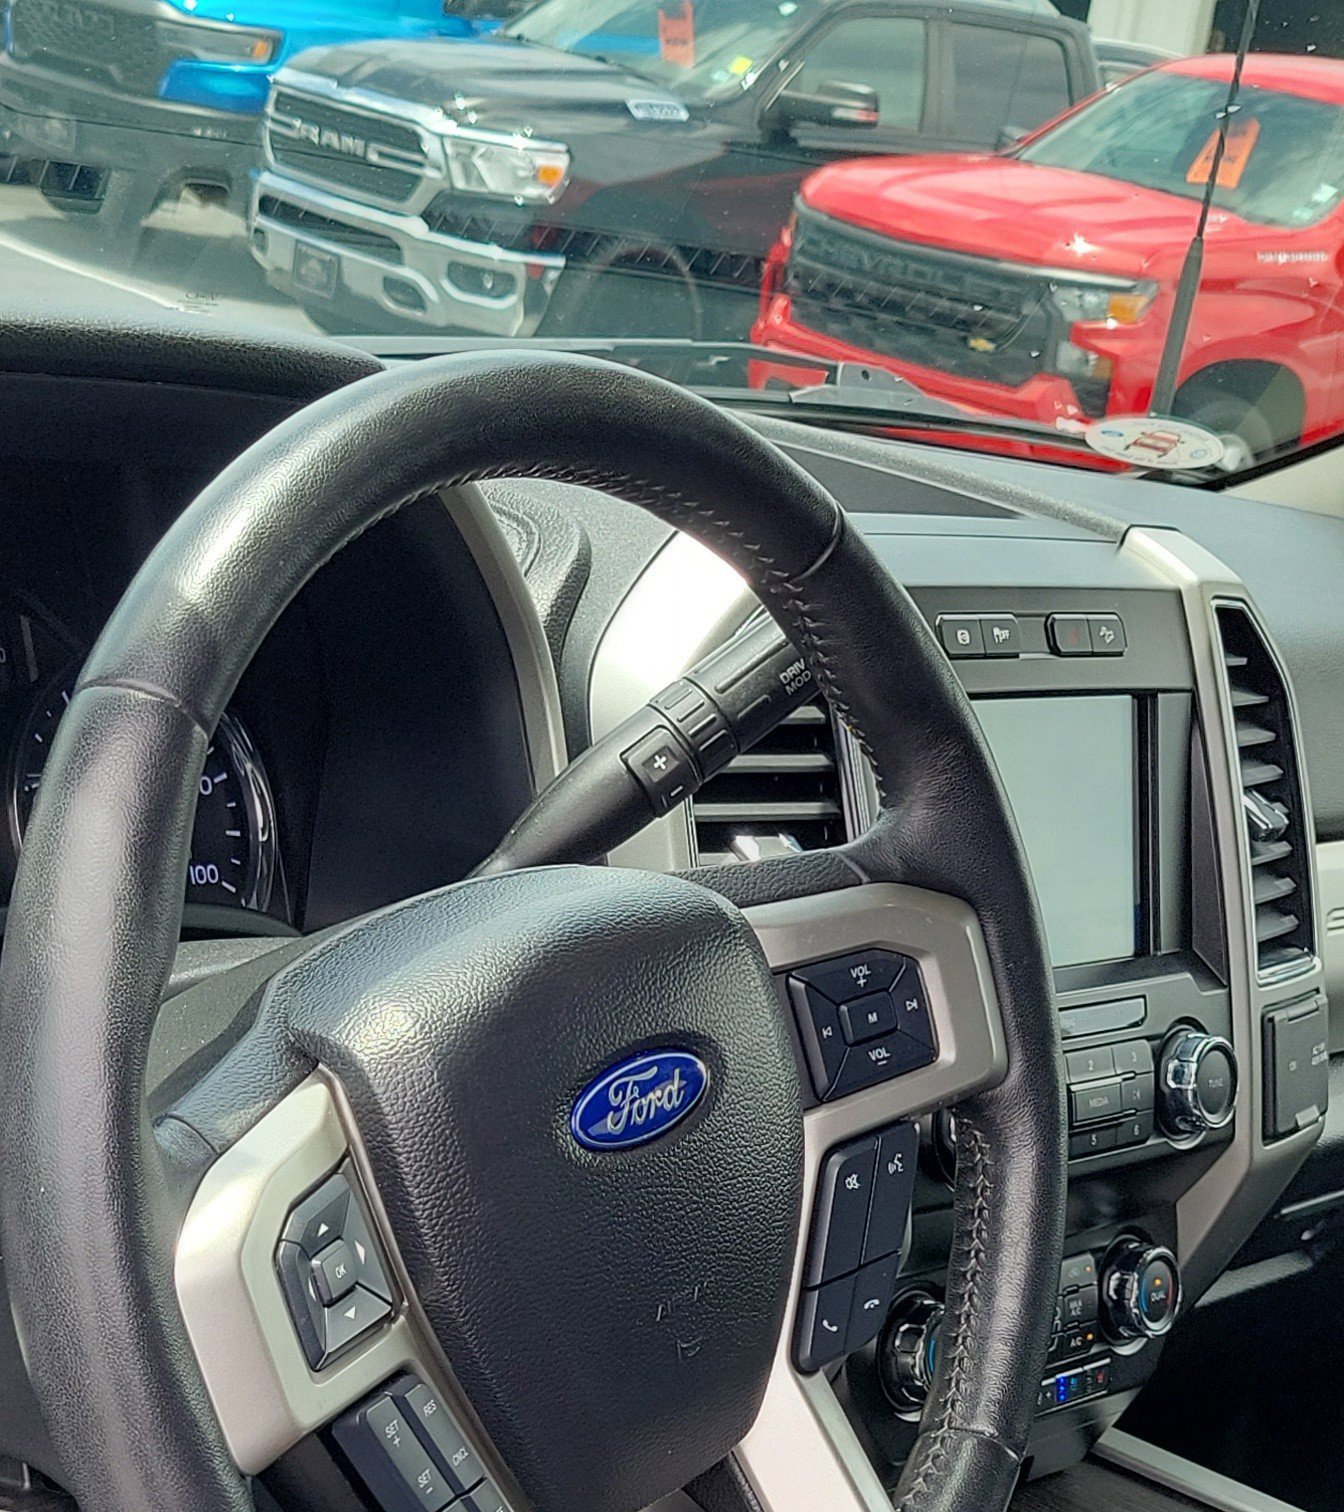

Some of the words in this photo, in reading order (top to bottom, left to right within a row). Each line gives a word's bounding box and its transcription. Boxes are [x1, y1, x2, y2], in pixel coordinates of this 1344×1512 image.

[299, 123, 366, 158] RAM
[779, 658, 806, 685] DRIV
[785, 670, 812, 695] MOD
[189, 864, 219, 885] 100
[850, 964, 871, 979] VOL
[867, 1012, 878, 1024] M
[868, 1046, 890, 1062] VOL
[1088, 1060, 1095, 1071] 2
[607, 1065, 685, 1135] Ford
[1134, 1124, 1141, 1136] 6
[1091, 1134, 1098, 1146] 5
[335, 1262, 347, 1279] OK
[423, 1399, 437, 1418] RES
[385, 1418, 400, 1439] SET
[452, 1447, 469, 1466] CNCL
[417, 1468, 431, 1488] SET
